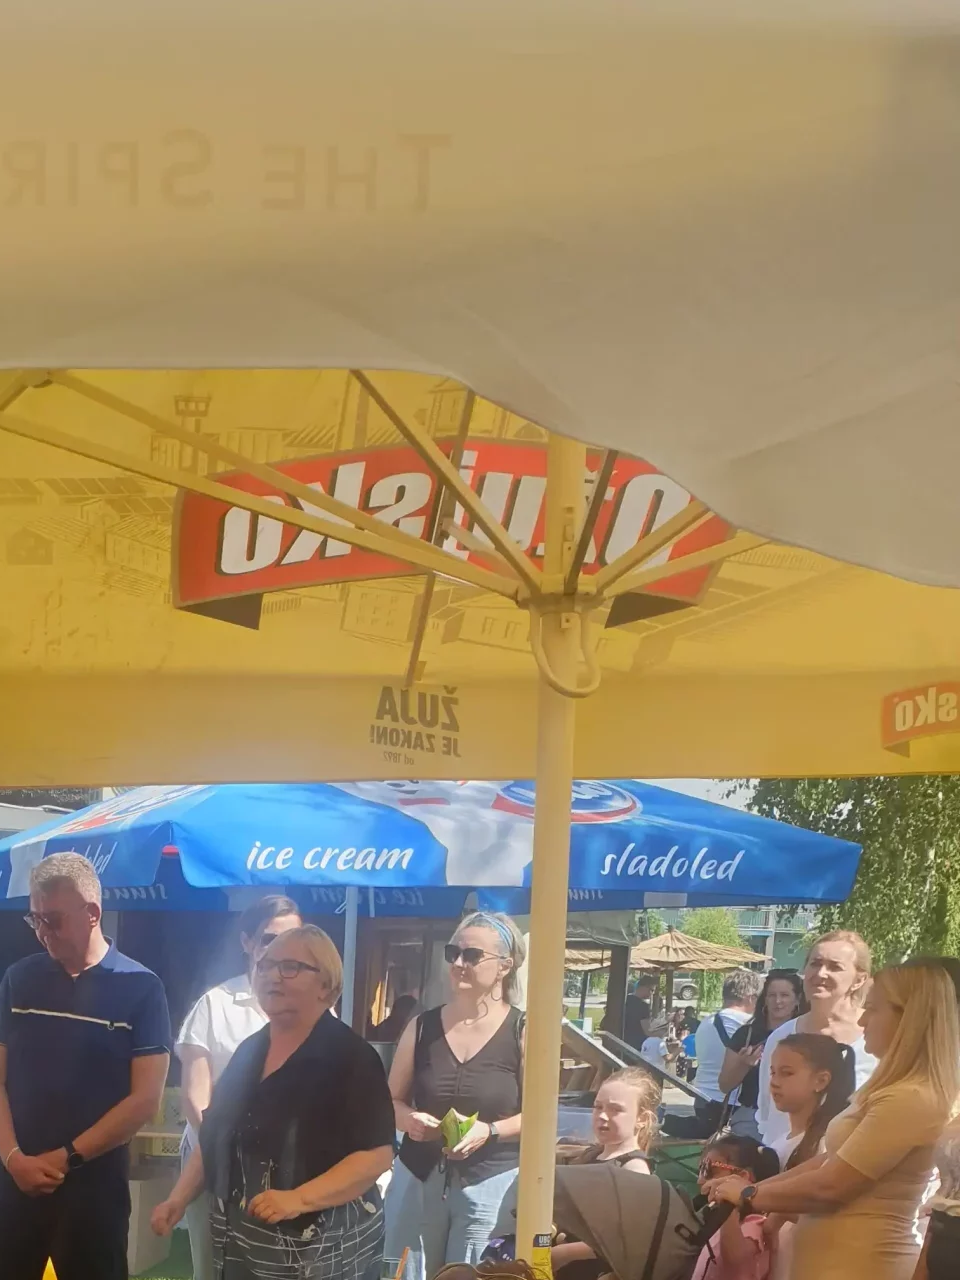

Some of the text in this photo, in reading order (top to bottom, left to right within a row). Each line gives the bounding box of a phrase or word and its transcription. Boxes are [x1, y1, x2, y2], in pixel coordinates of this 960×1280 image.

[246, 841, 414, 871] ice cream
[600, 842, 746, 882] sladoled
